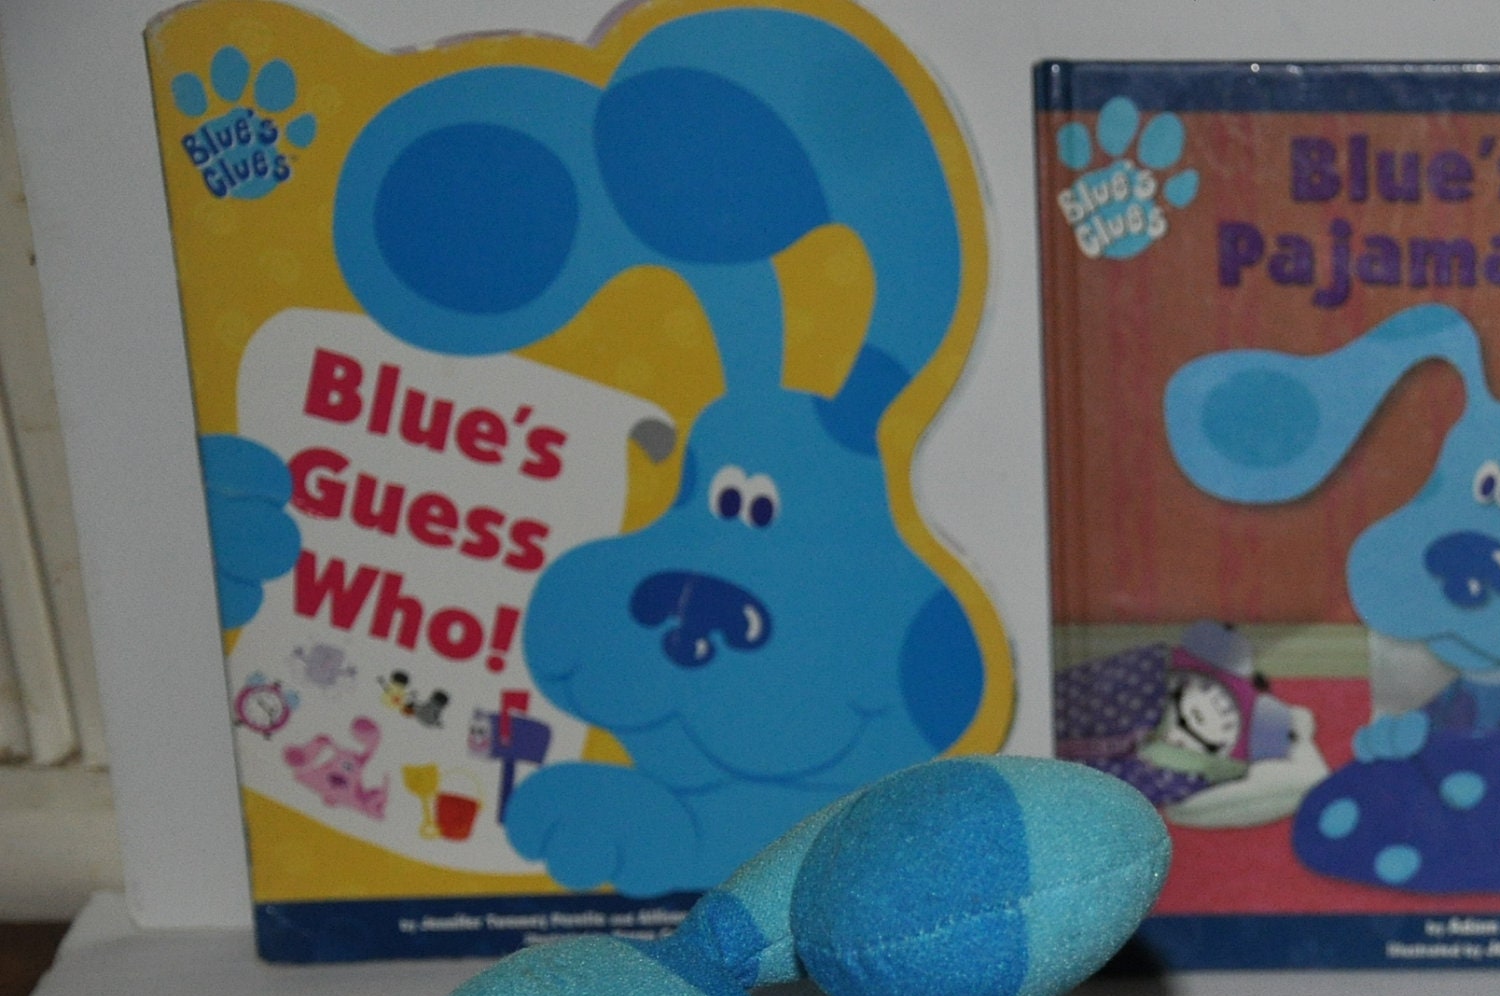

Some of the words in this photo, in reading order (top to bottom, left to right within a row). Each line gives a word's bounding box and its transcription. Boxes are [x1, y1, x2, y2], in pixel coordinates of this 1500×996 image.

[180, 108, 279, 168] Blue's
[201, 149, 292, 199] Clues
[1057, 159, 1157, 226] Blue's
[1075, 203, 1168, 258] Clues
[304, 347, 568, 482] Blue's
[287, 446, 551, 572] Guess
[292, 548, 520, 673] Who!
